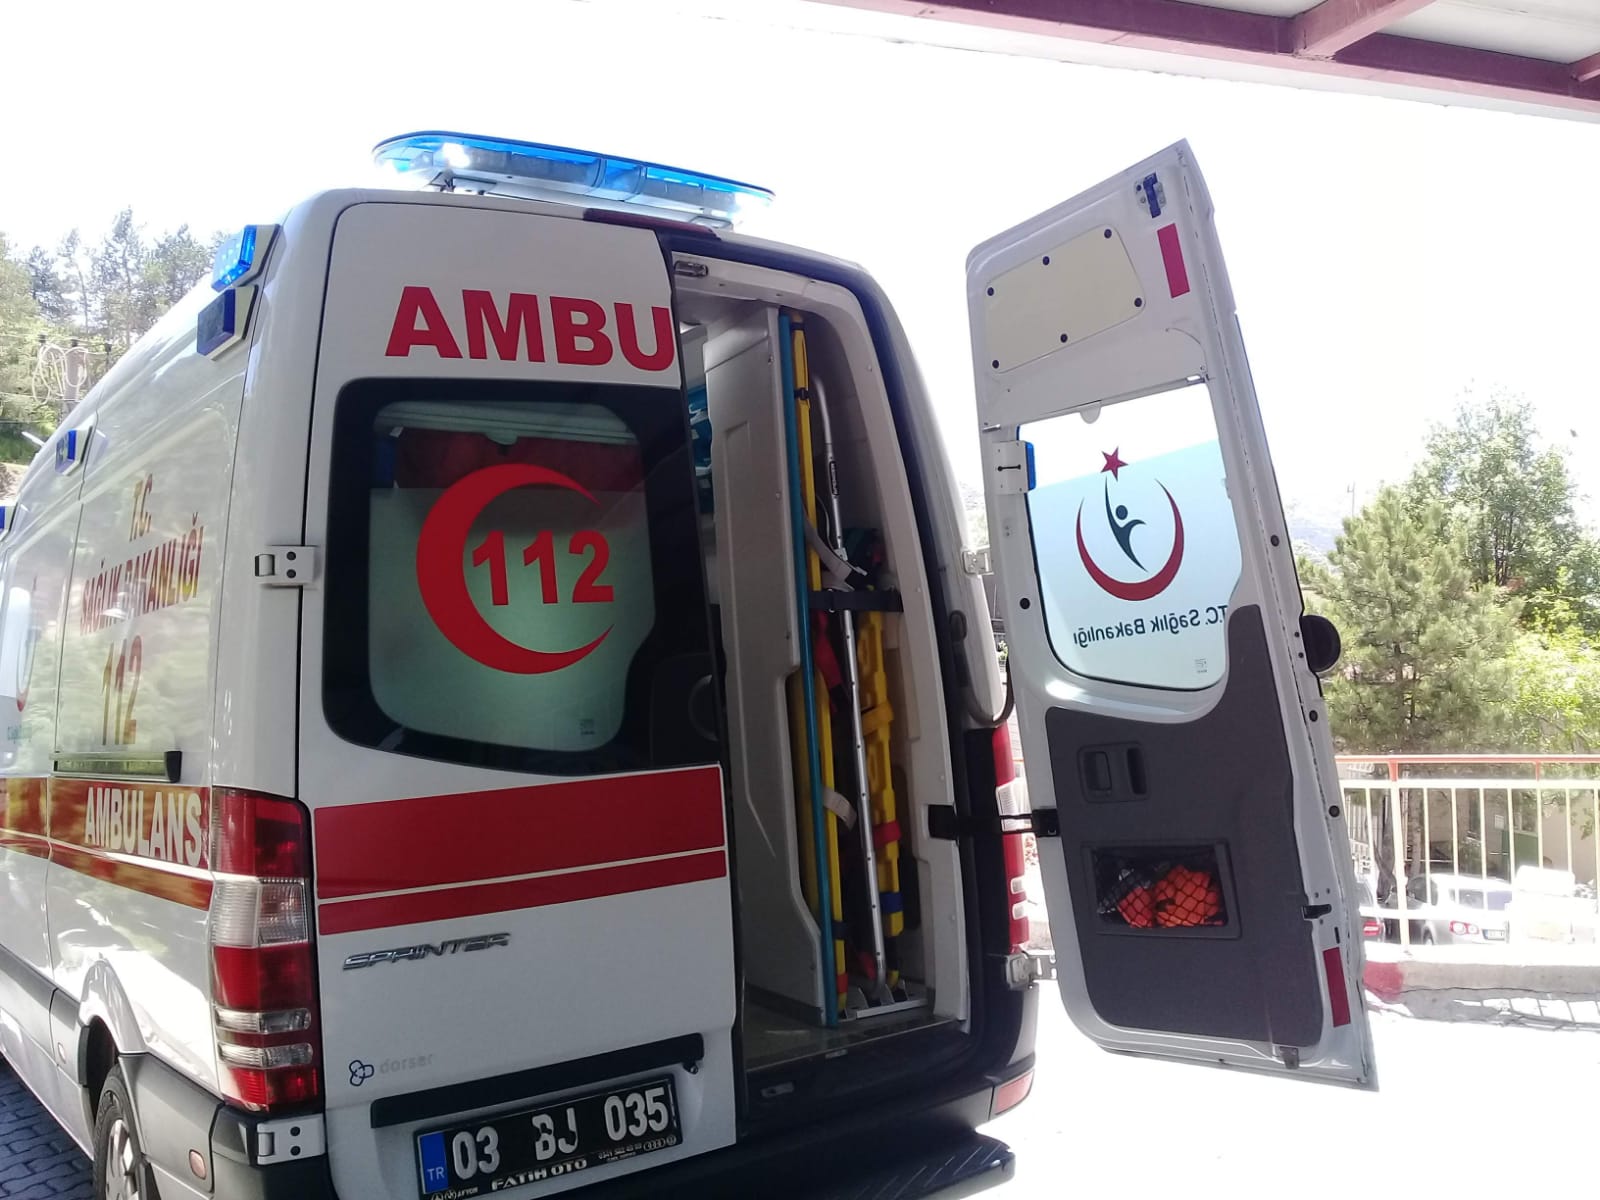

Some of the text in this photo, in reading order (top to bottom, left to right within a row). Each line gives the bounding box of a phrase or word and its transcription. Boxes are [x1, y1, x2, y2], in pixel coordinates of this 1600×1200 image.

[385, 286, 675, 371] AMBU
[472, 530, 613, 606] 112
[102, 635, 143, 745] 112
[83, 787, 202, 867] AMBULANS
[343, 932, 511, 971] SPRINTER
[427, 1086, 669, 1181] TR 03 BJ 035
[551, 1158, 587, 1176] OTO
